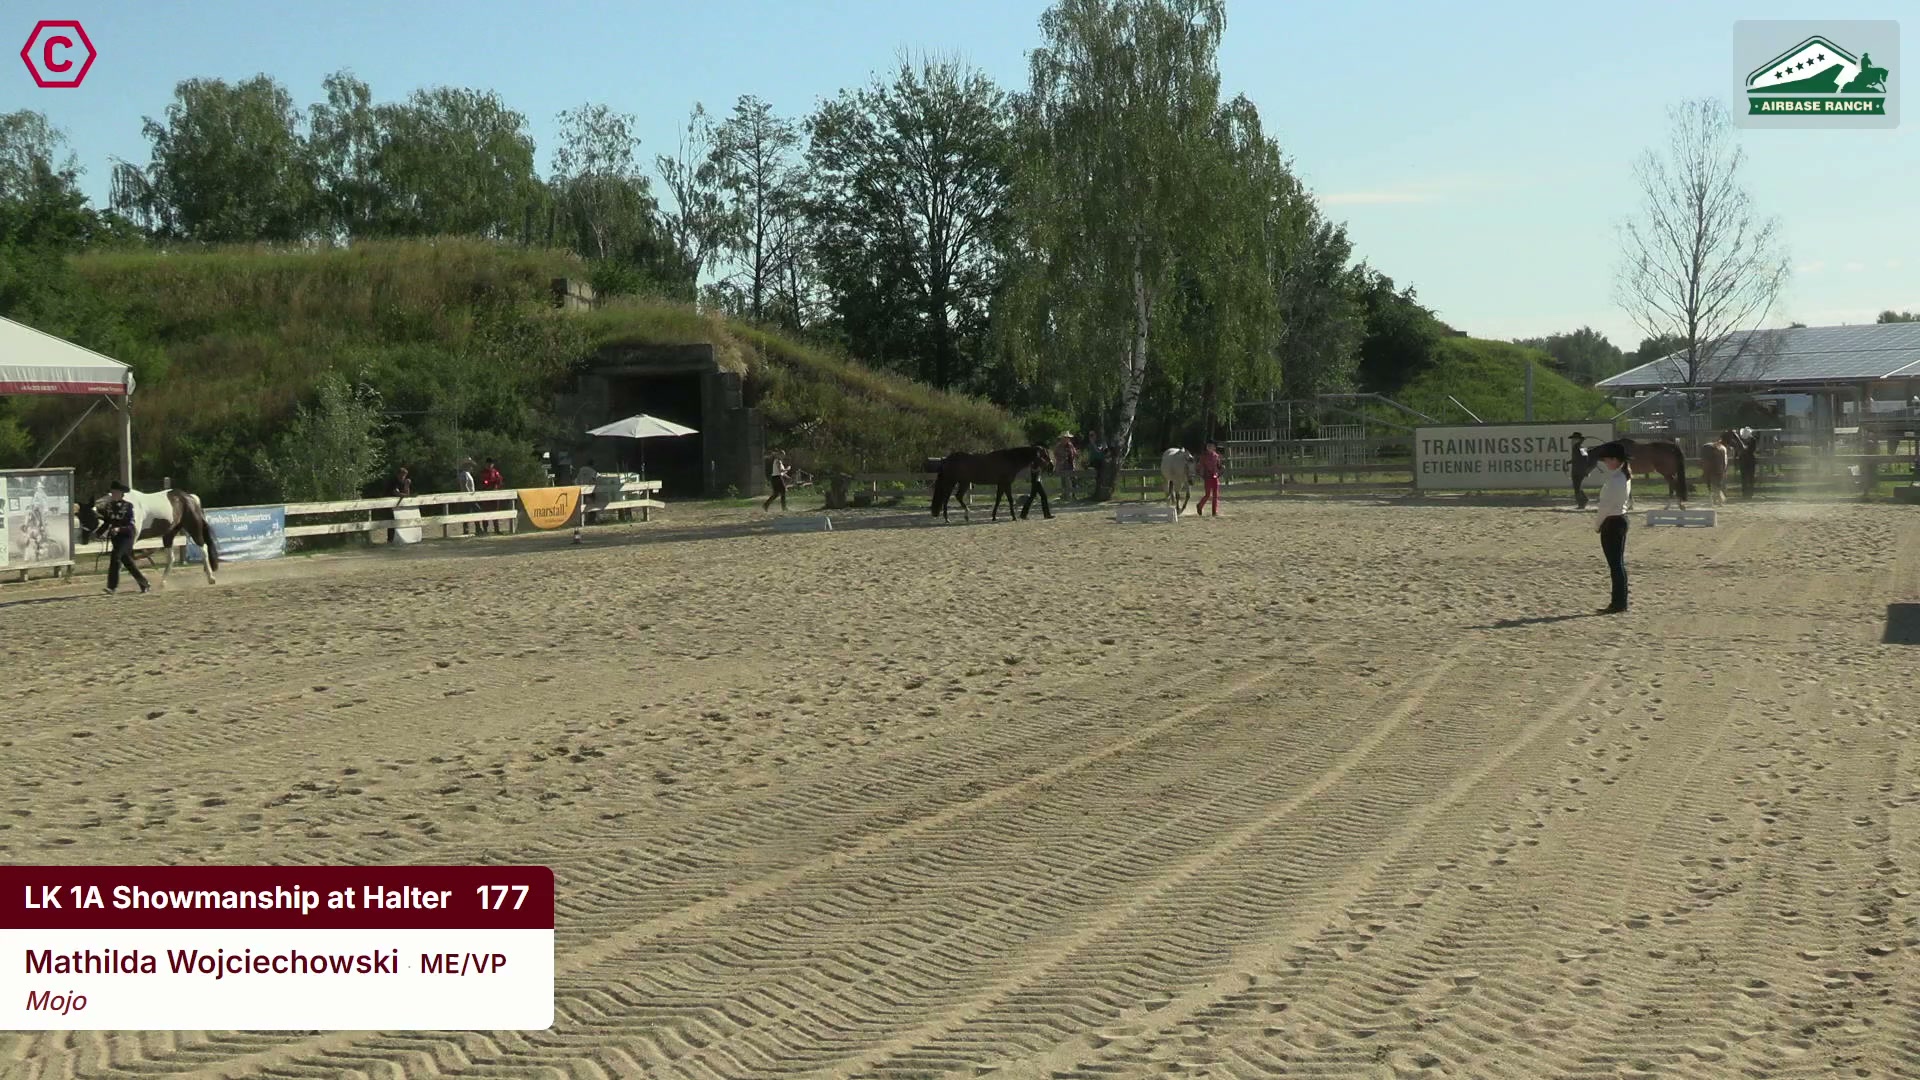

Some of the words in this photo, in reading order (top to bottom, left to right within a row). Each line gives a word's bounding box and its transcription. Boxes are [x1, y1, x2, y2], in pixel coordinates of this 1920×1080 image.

[1422, 437, 1569, 455] TRAININGSSTAL
[1423, 460, 1481, 474] ETIENNE
[1488, 458, 1569, 473] HIRSCHFEL
[533, 503, 565, 518] marstall
